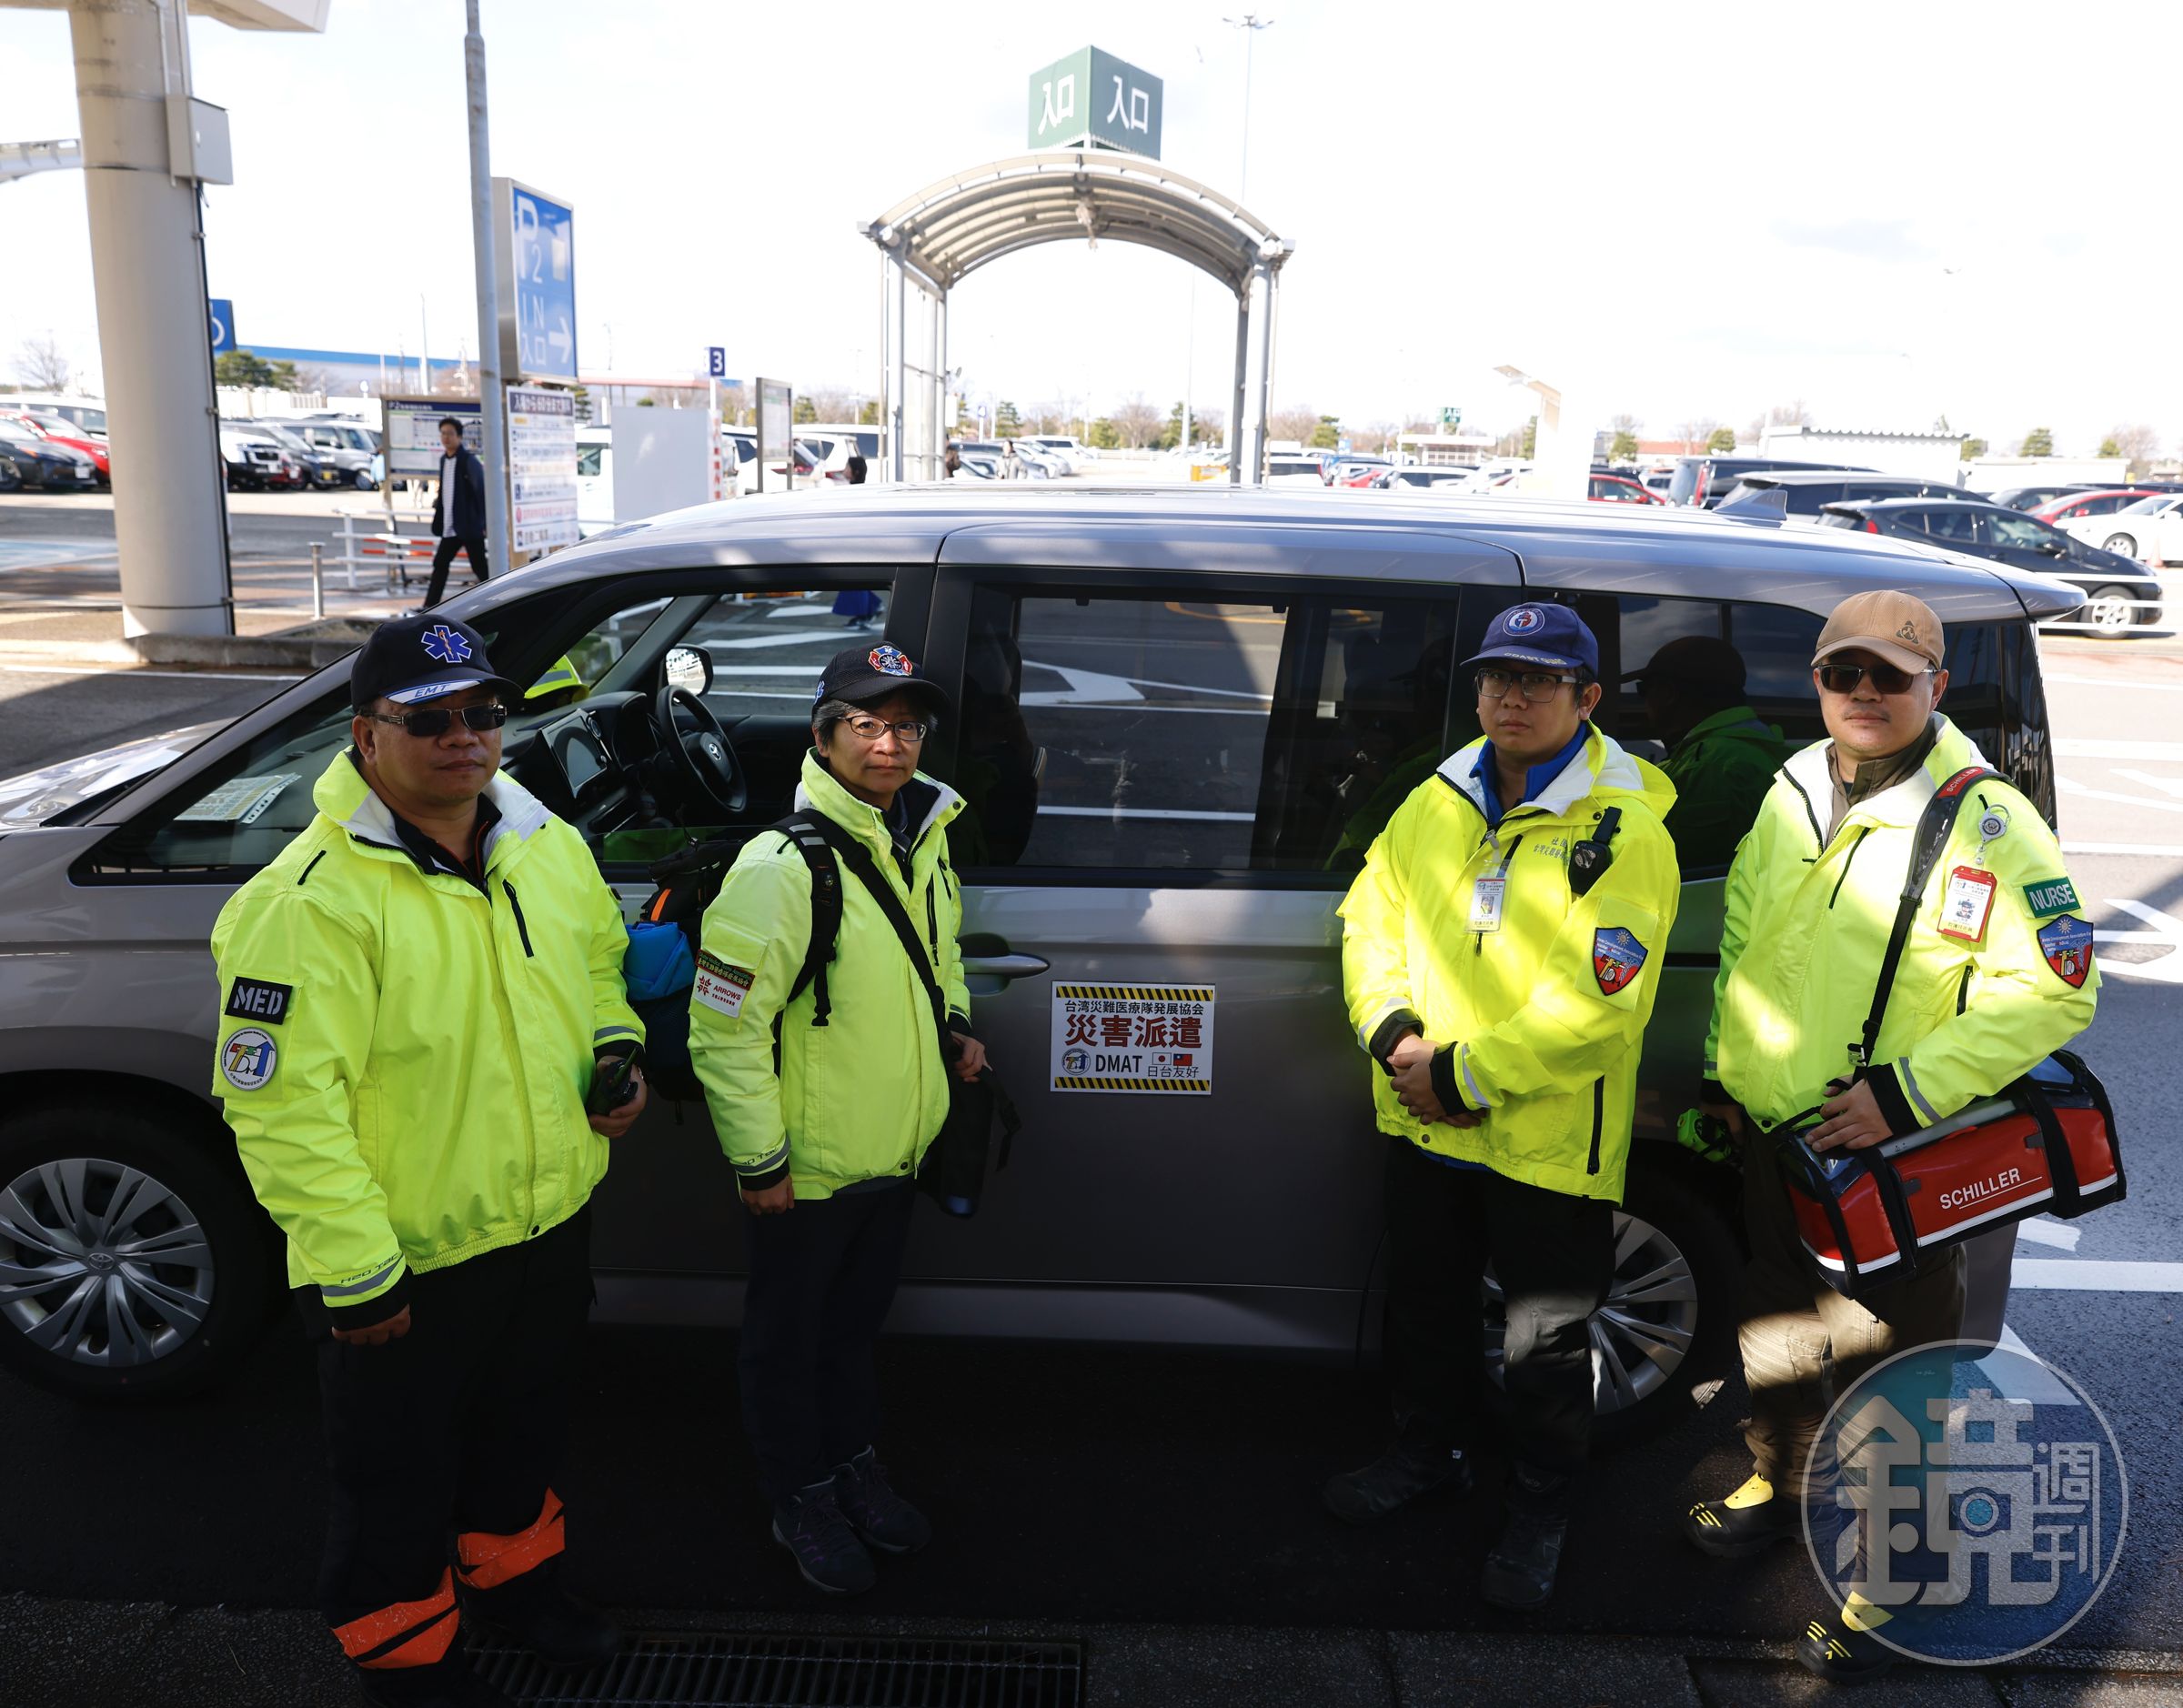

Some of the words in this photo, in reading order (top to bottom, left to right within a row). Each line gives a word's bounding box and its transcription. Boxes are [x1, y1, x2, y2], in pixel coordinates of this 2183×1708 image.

[1038, 74, 1075, 136] 入口
[1106, 75, 1149, 135] 入口
[522, 293, 544, 329] IN
[522, 333, 546, 365] 入口
[712, 350, 723, 373] 3
[414, 684, 449, 698] EMT
[2029, 884, 2075, 910] NURSE
[233, 985, 284, 1015] MED
[713, 985, 741, 1000] ARROWS
[1064, 1000, 1204, 1016] 台湾災難医療隊発展協会
[1064, 1013, 1202, 1049] 災害派遣
[1095, 1054, 1142, 1073] DMAT
[1147, 1066, 1200, 1079] 日台友好
[1939, 1168, 2021, 1210] SCHILLER
